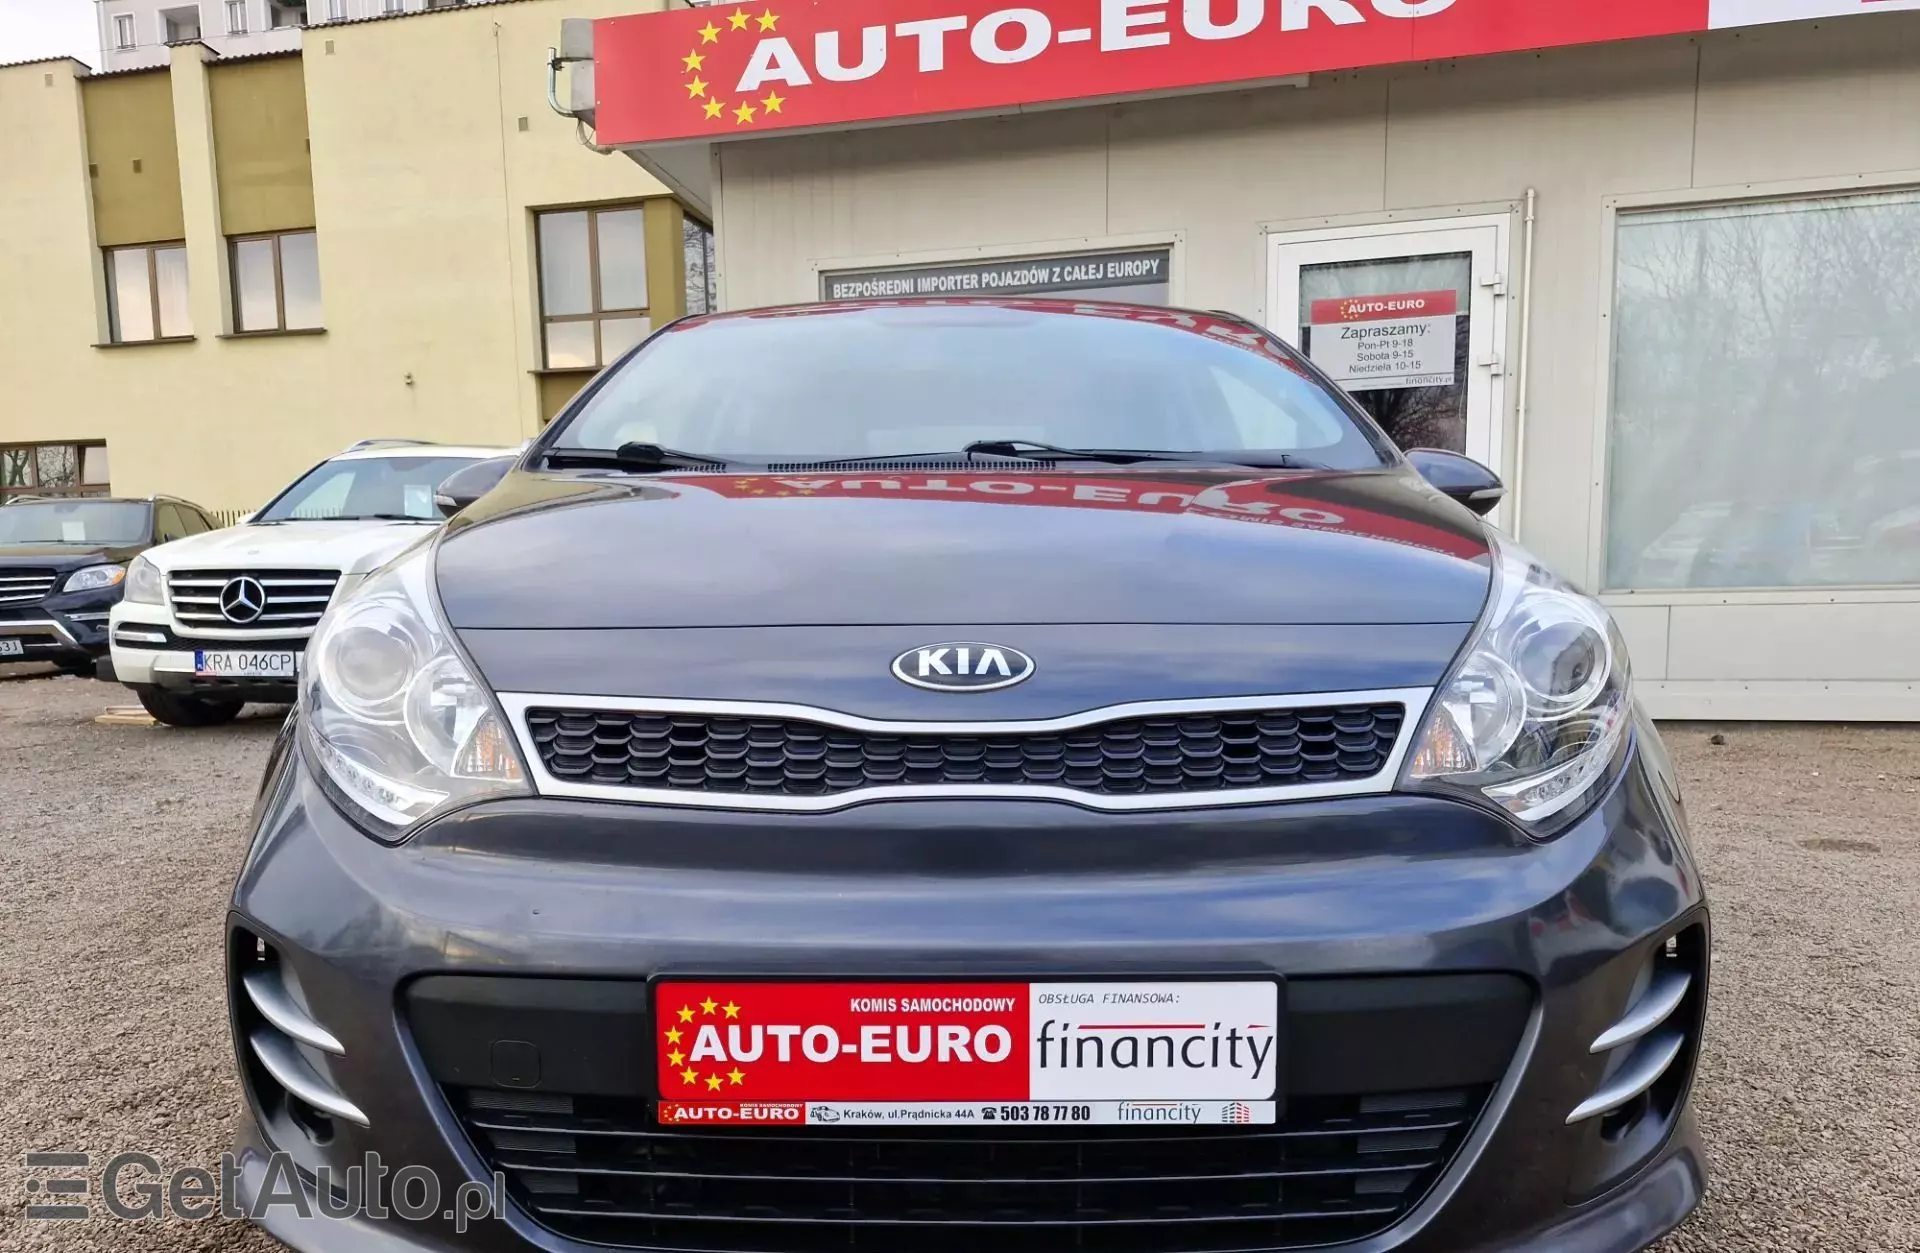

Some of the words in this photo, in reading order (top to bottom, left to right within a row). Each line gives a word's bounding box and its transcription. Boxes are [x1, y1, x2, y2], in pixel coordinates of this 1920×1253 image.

[833, 280, 914, 299] BEZPOŚREDNI
[917, 275, 979, 293] IMPORTER
[982, 269, 1049, 288] POJAZDÓW
[1052, 266, 1061, 283] Z
[1064, 262, 1104, 282] CAŁEJ
[1107, 258, 1160, 278] EUROPY
[1348, 299, 1425, 314] AUTO-EURO
[1341, 323, 1432, 341] Zapraszamy:
[1357, 341, 1390, 350] Pon-Pt
[1392, 339, 1413, 349] 9-18
[1357, 352, 1390, 362] Sobota
[1392, 350, 1414, 360] 9-15
[1349, 363, 1392, 374] Niedziela
[1395, 361, 1421, 371] 10-15
[204, 654, 233, 671] KRA
[238, 654, 291, 671] 046CP
[917, 647, 1012, 677] KIA
[850, 997, 897, 1013] KOMIS
[901, 997, 1016, 1013] SAMOCHODOWY
[1038, 993, 1095, 1005] OBSŁUGA
[1102, 993, 1182, 1004] FINANSOWA:
[689, 1024, 1012, 1063] AUTO-EURO
[1036, 1019, 1274, 1080] financity
[674, 1107, 800, 1120] AUTO-EURO
[843, 1108, 885, 1120] Kraków,
[955, 1109, 975, 1119] 44A
[1000, 1105, 1030, 1121] 503
[1033, 1105, 1050, 1121] 78
[1053, 1105, 1071, 1121] 77
[1071, 1105, 1091, 1121] 80
[1117, 1101, 1201, 1124] financity
